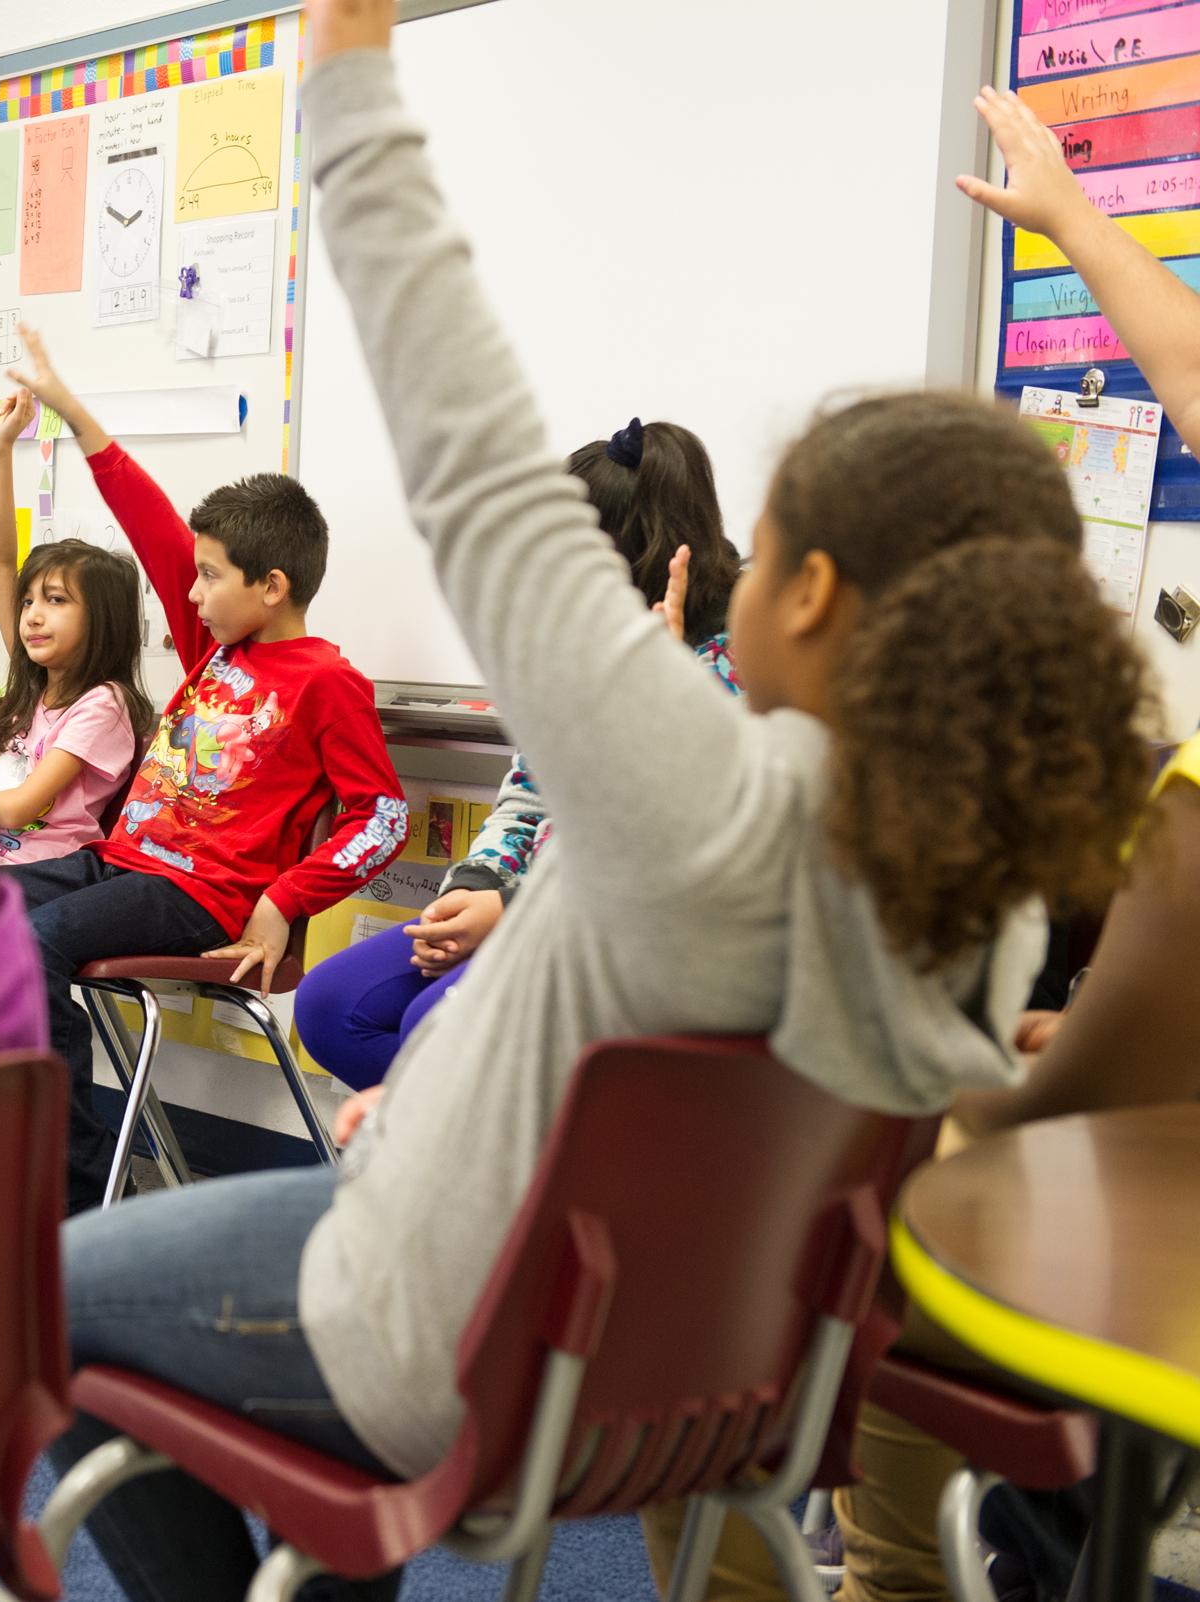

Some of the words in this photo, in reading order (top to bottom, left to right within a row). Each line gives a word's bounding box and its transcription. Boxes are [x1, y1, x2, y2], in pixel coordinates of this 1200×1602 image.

[1037, 46, 1087, 71] Music
[1114, 38, 1145, 62] P.E.
[195, 85, 223, 105] Elapsed
[238, 80, 256, 91] Time
[1062, 84, 1129, 116] Writing
[151, 99, 164, 108] hand
[35, 128, 57, 144] Factor
[62, 123, 74, 138] Fun
[131, 122, 142, 133] long
[210, 133, 218, 146] 3
[225, 132, 252, 145] hours
[252, 181, 272, 196] 5:49
[179, 194, 199, 211] 2:49
[207, 233, 232, 244] Shopping
[234, 229, 254, 239] Record
[1016, 332, 1066, 362] Closing
[1074, 328, 1110, 351] Circle
